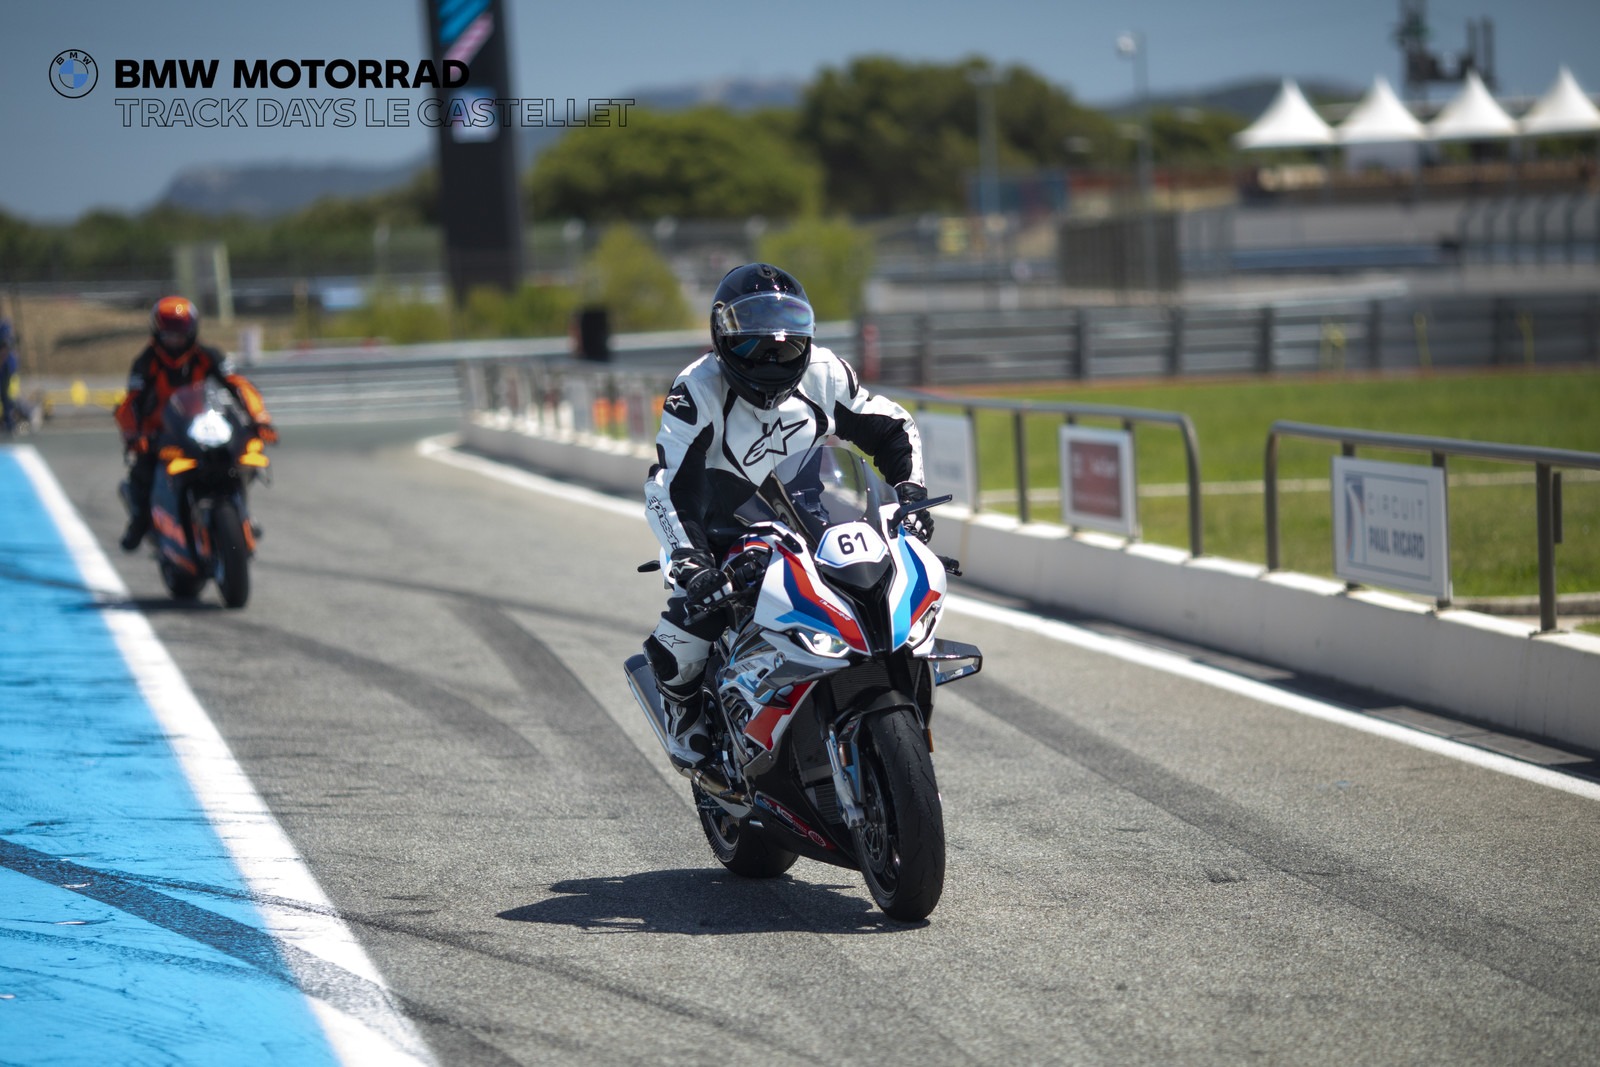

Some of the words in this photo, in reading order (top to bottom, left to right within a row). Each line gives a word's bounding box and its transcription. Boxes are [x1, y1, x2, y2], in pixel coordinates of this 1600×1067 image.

[1368, 491, 1424, 521] CIRCUIT
[837, 532, 868, 555] 61
[1369, 525, 1391, 555] PAUL
[1392, 529, 1425, 561] RICARD
